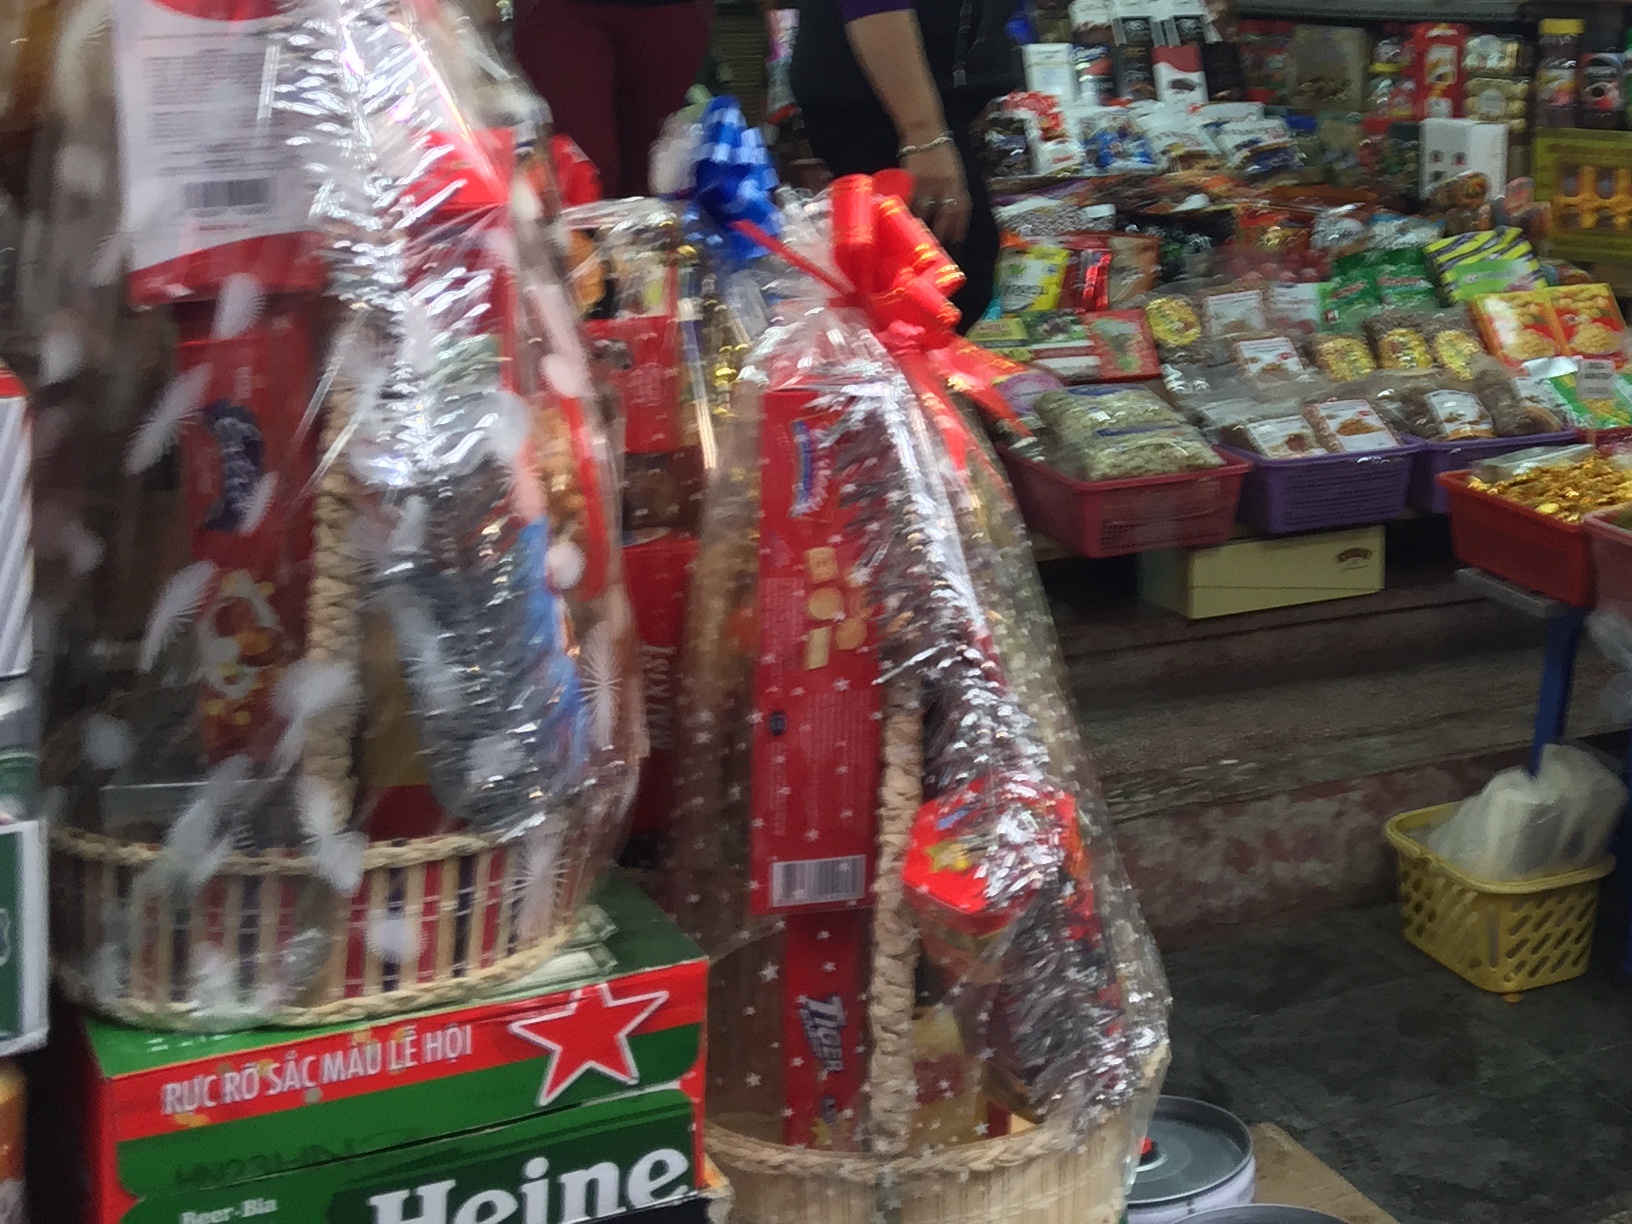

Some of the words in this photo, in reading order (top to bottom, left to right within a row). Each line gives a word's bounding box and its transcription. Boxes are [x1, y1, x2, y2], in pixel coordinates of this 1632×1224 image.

[266, 1049, 318, 1096] SẮC
[424, 1022, 473, 1064] HỘI
[368, 1147, 690, 1224] Heine
